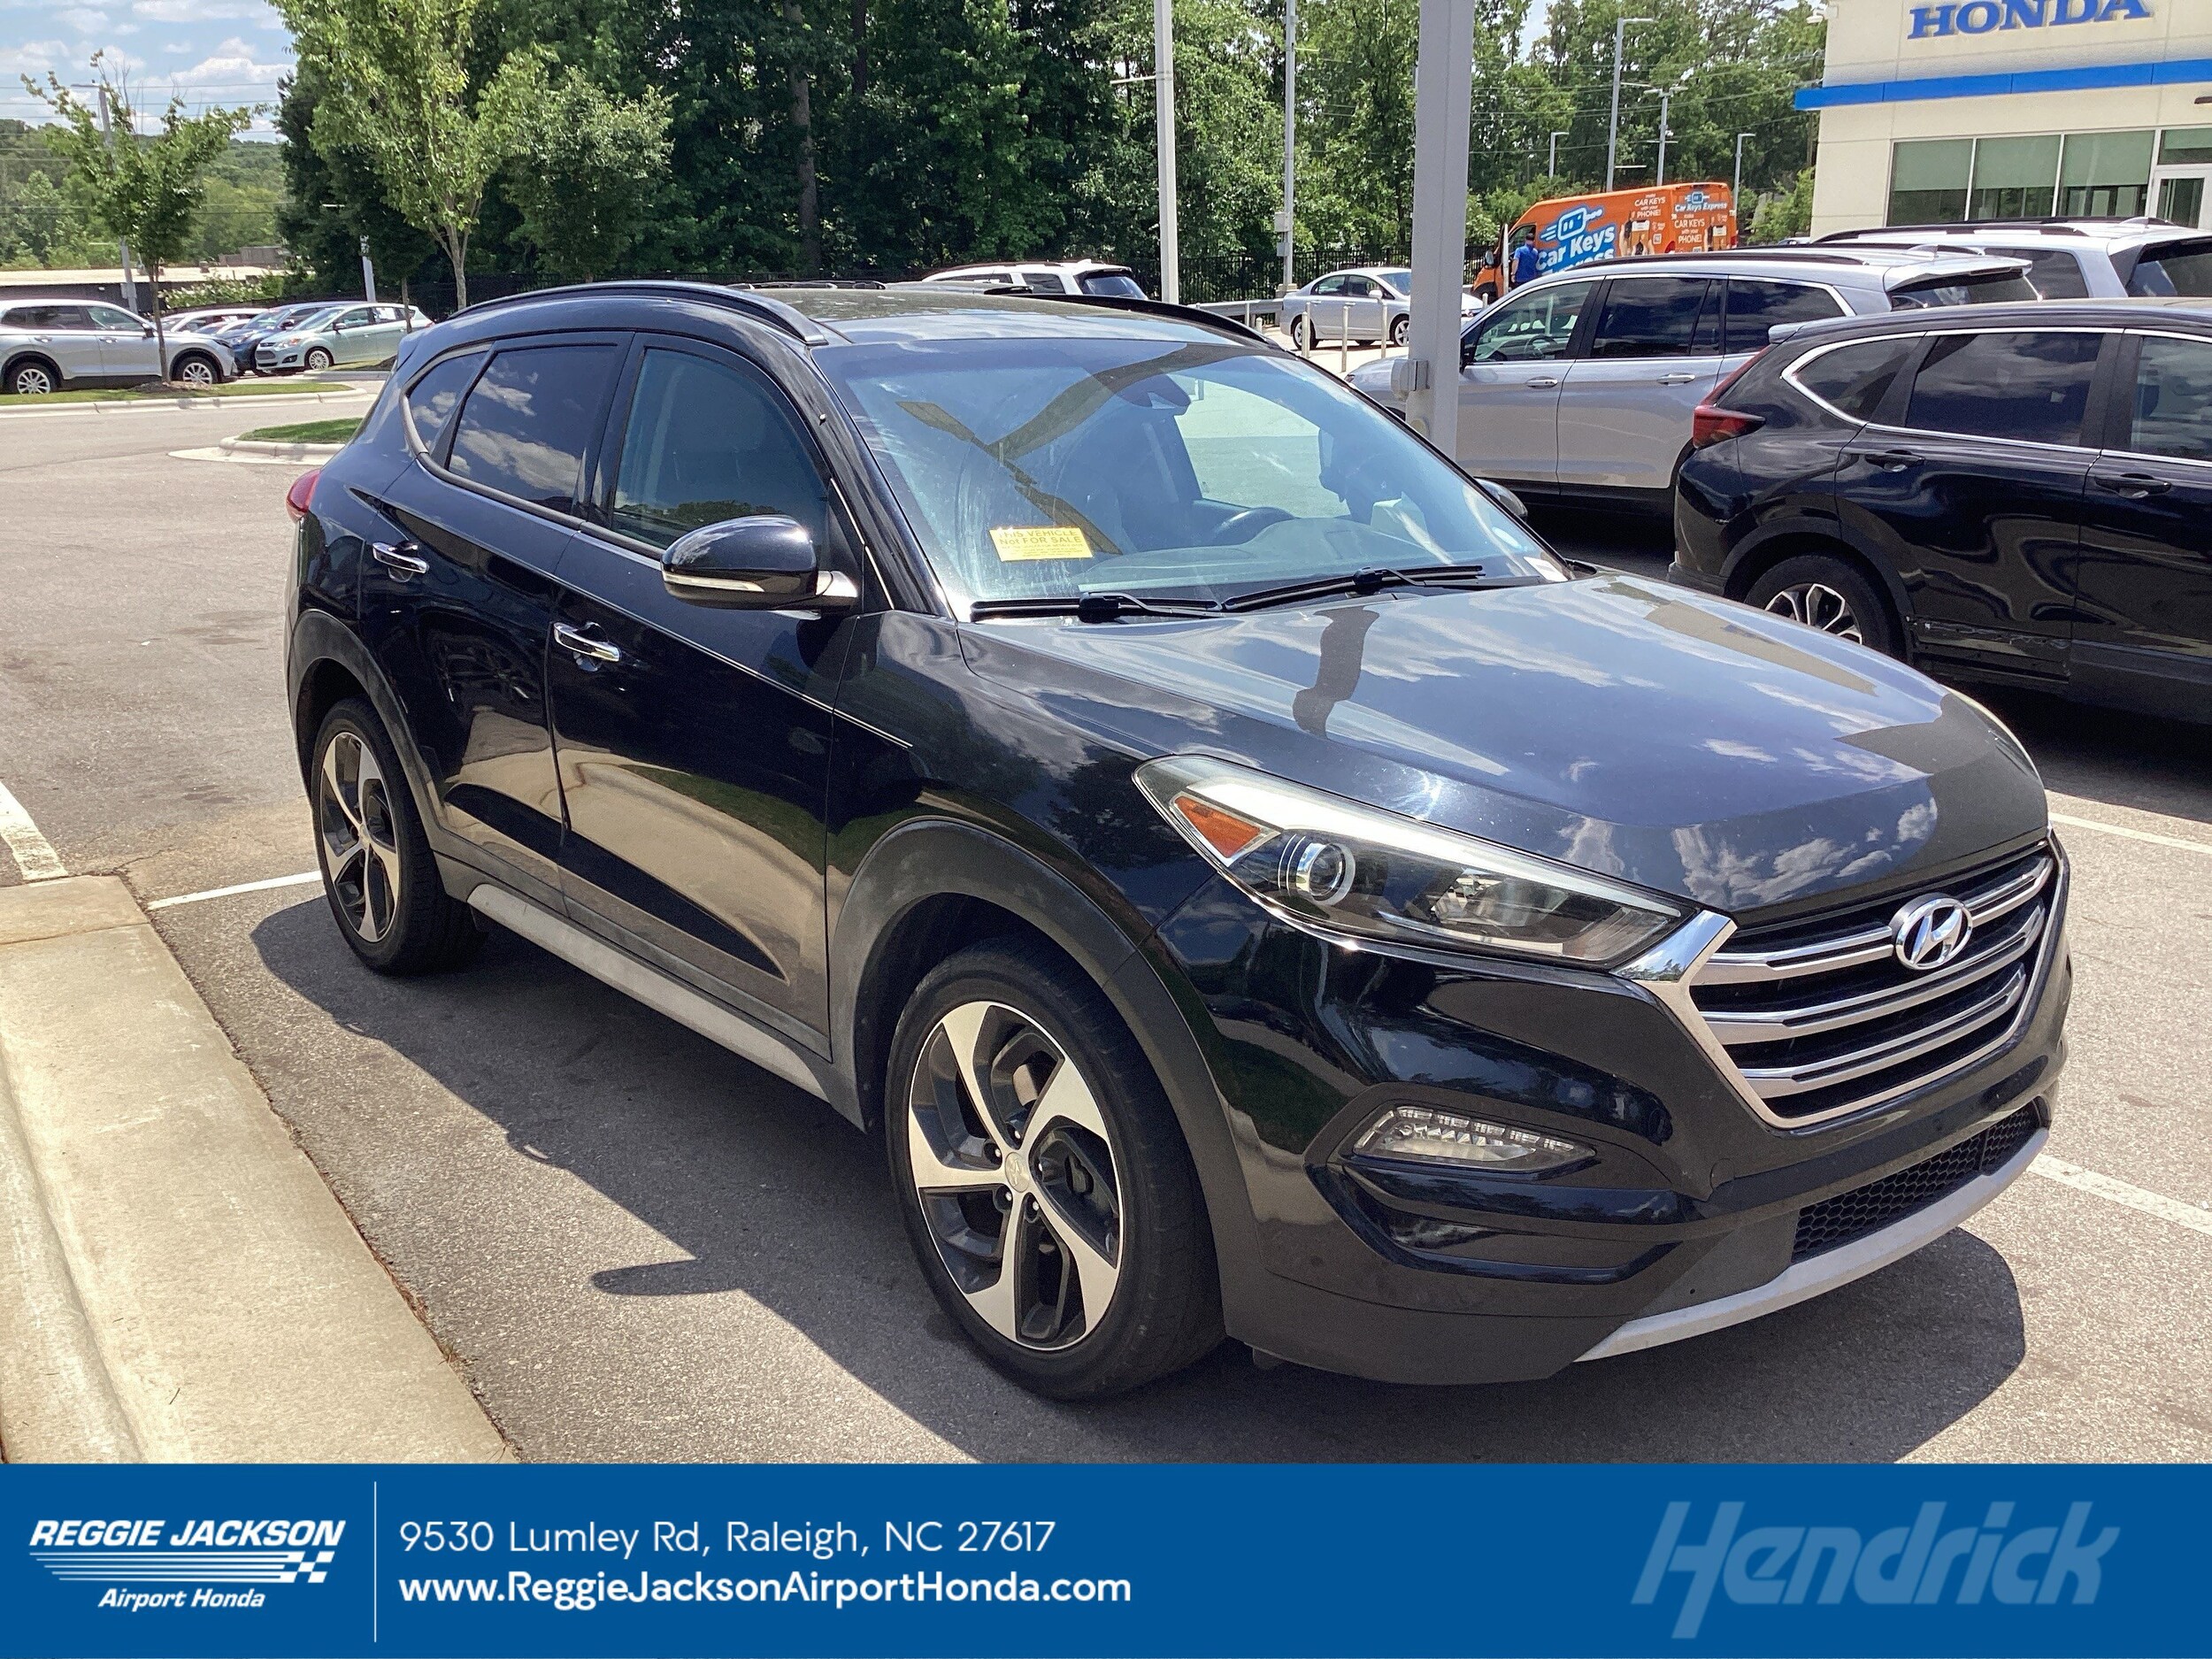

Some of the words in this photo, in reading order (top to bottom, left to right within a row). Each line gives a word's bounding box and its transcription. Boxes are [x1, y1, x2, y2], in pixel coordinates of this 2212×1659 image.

[1908, 0, 2154, 40] HONDA
[1634, 198, 1648, 207] CAR
[1648, 196, 1666, 205] KEYS
[1675, 204, 1686, 212] Car
[1686, 203, 1701, 212] Keys
[1702, 203, 1727, 211] Express
[1636, 209, 1661, 219] PHONE!
[1674, 219, 1688, 228] CAR
[1688, 219, 1705, 227] KEYS
[1678, 234, 1702, 244] PHONE!
[1535, 245, 1567, 271] Car
[1570, 226, 1615, 258] Keys
